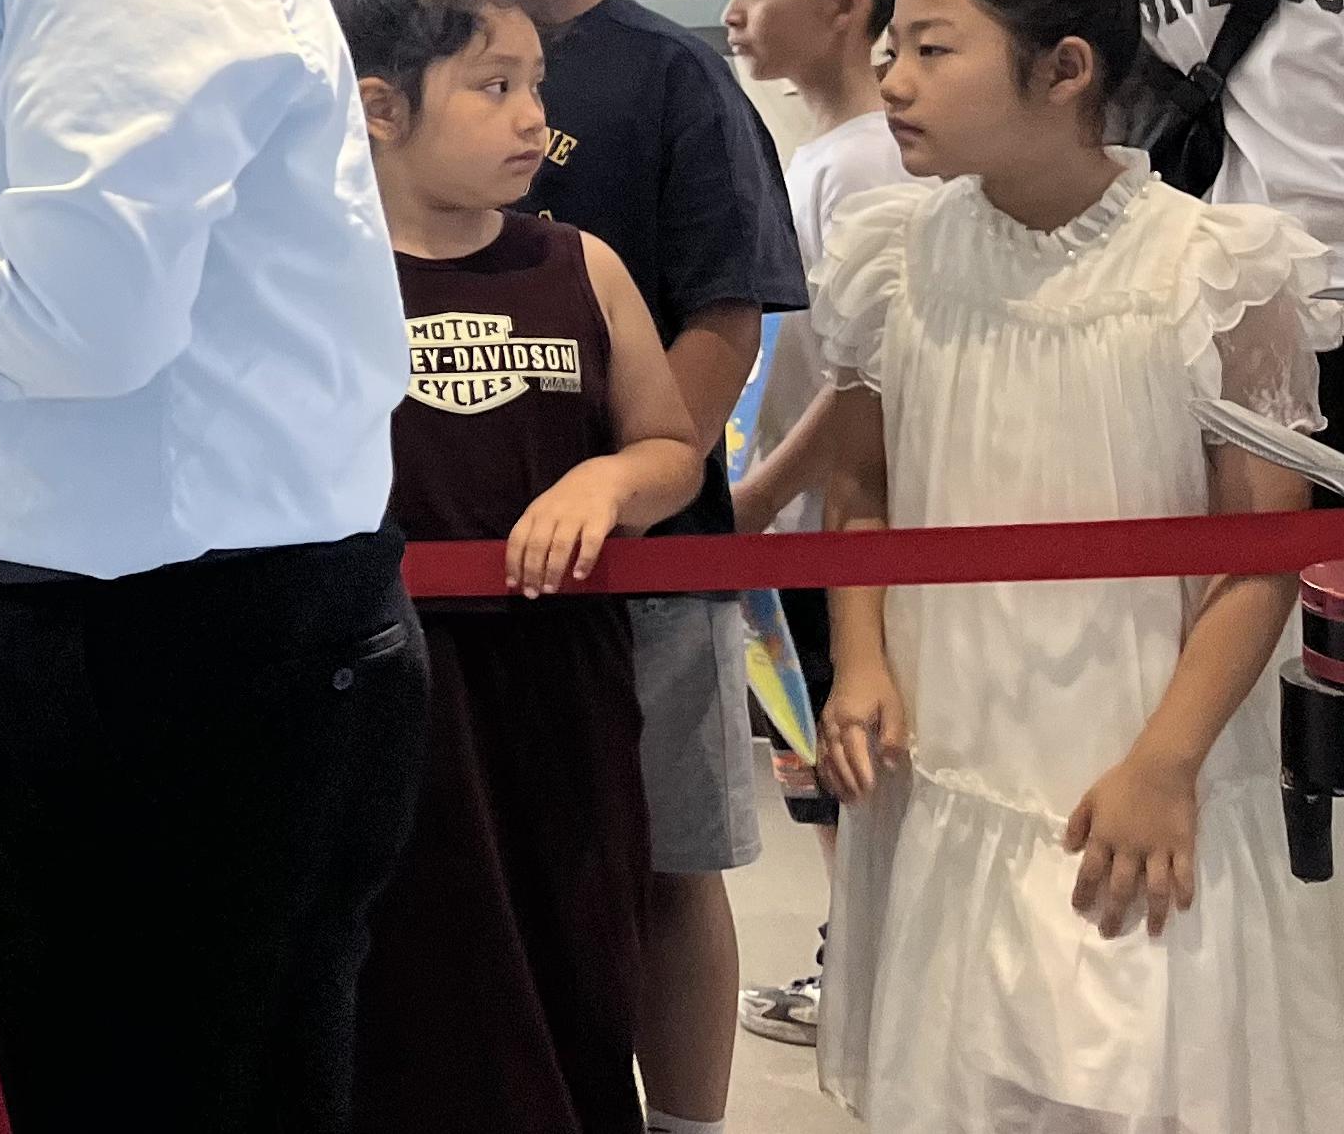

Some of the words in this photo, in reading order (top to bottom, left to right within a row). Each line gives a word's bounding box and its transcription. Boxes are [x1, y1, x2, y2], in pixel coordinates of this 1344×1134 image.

[410, 319, 500, 341] MOTOR
[411, 345, 577, 373] EY-DAVIDSON
[417, 376, 513, 407] CYCLES
